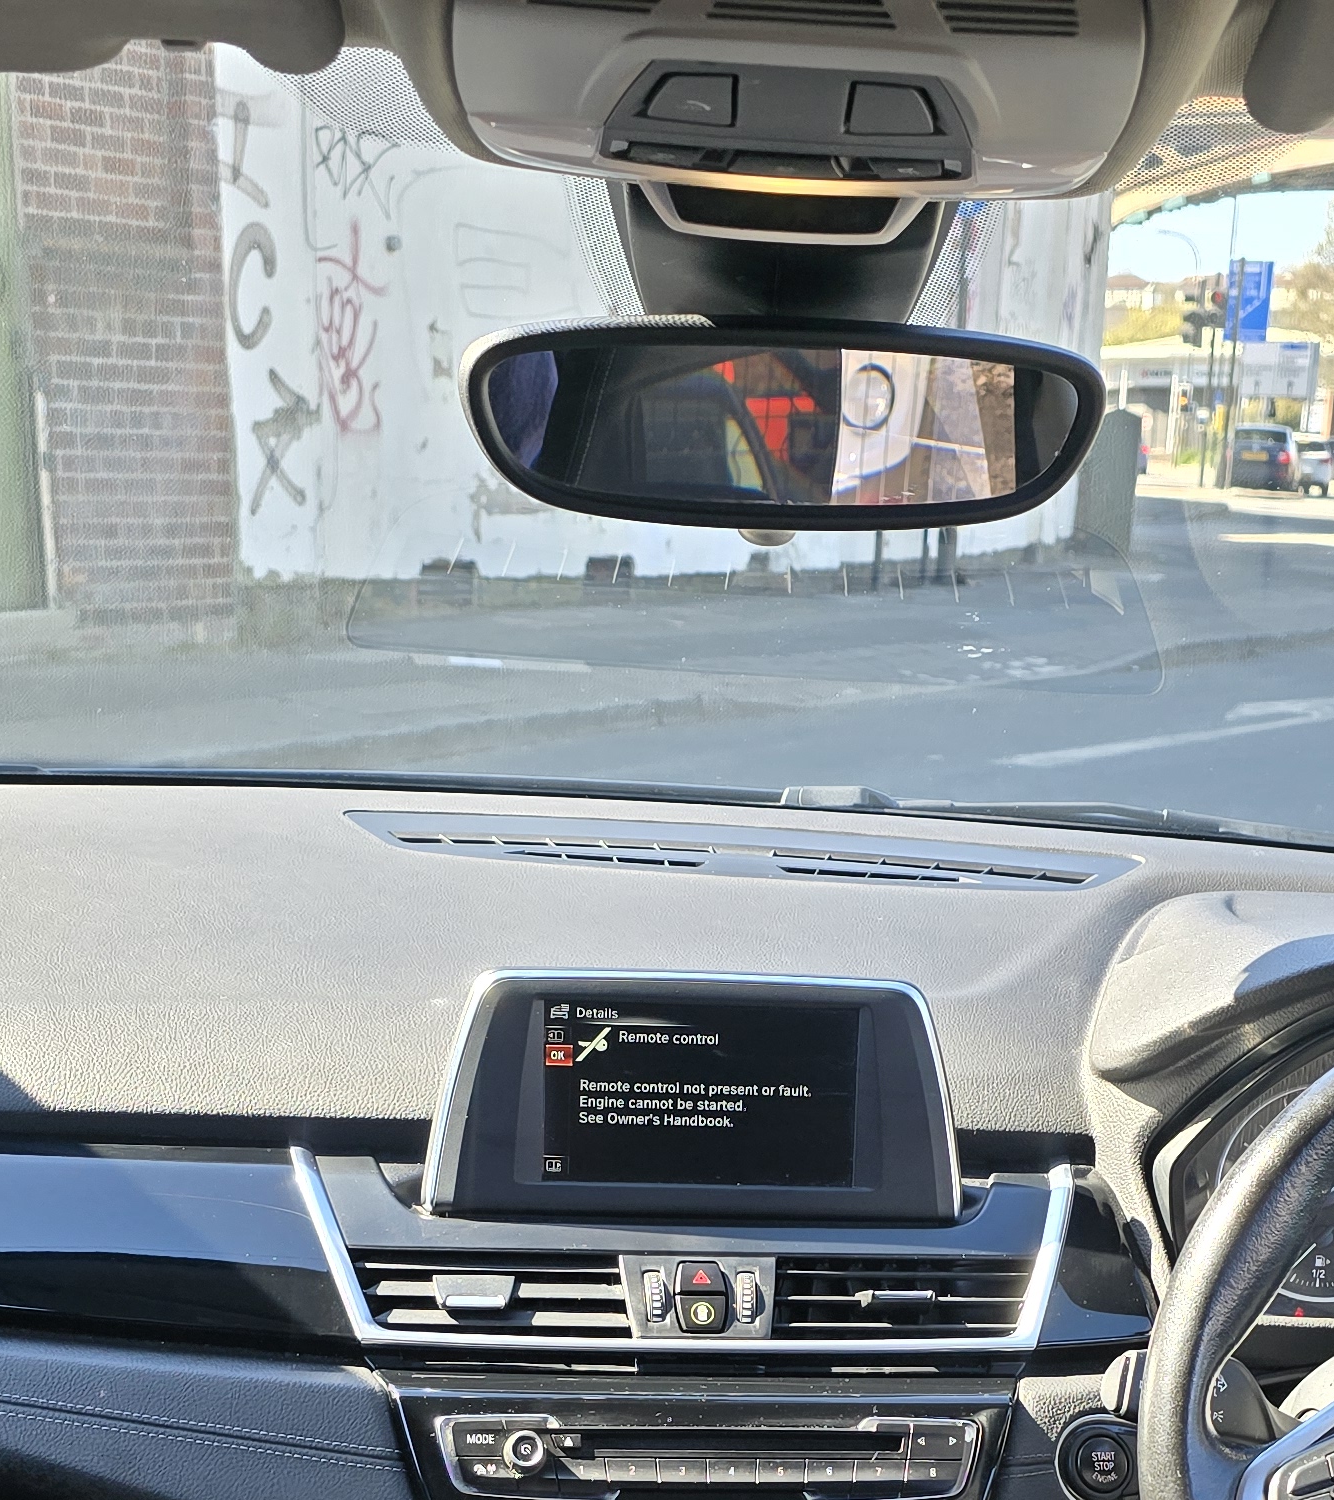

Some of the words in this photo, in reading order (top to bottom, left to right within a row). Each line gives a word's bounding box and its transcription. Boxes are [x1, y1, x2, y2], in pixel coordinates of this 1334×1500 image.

[576, 1007, 619, 1019] Details
[618, 1030, 669, 1044] Remote
[672, 1033, 719, 1046] control
[550, 1050, 566, 1061] OK
[579, 1079, 631, 1092] Remote
[633, 1081, 680, 1094] control
[683, 1083, 706, 1095] not
[708, 1084, 759, 1098] present
[761, 1086, 776, 1097] or
[778, 1085, 812, 1097] fault.
[579, 1095, 625, 1110] Engine
[628, 1098, 674, 1110] cannot
[677, 1098, 694, 1110] be
[696, 1099, 747, 1112] started.
[578, 1111, 604, 1124] See
[607, 1112, 661, 1126] Owner's
[663, 1114, 734, 1128] Handbook.
[1312, 1269, 1325, 1279] 1/2
[467, 1434, 495, 1445] MODE
[1091, 1452, 1115, 1461] START
[629, 1466, 636, 1475] 2
[679, 1466, 686, 1476] 3
[728, 1466, 735, 1476] 4
[777, 1467, 784, 1476] 5
[875, 1467, 882, 1477] 7
[1094, 1461, 1114, 1471] STOP
[1091, 1471, 1118, 1483] ENGINE
